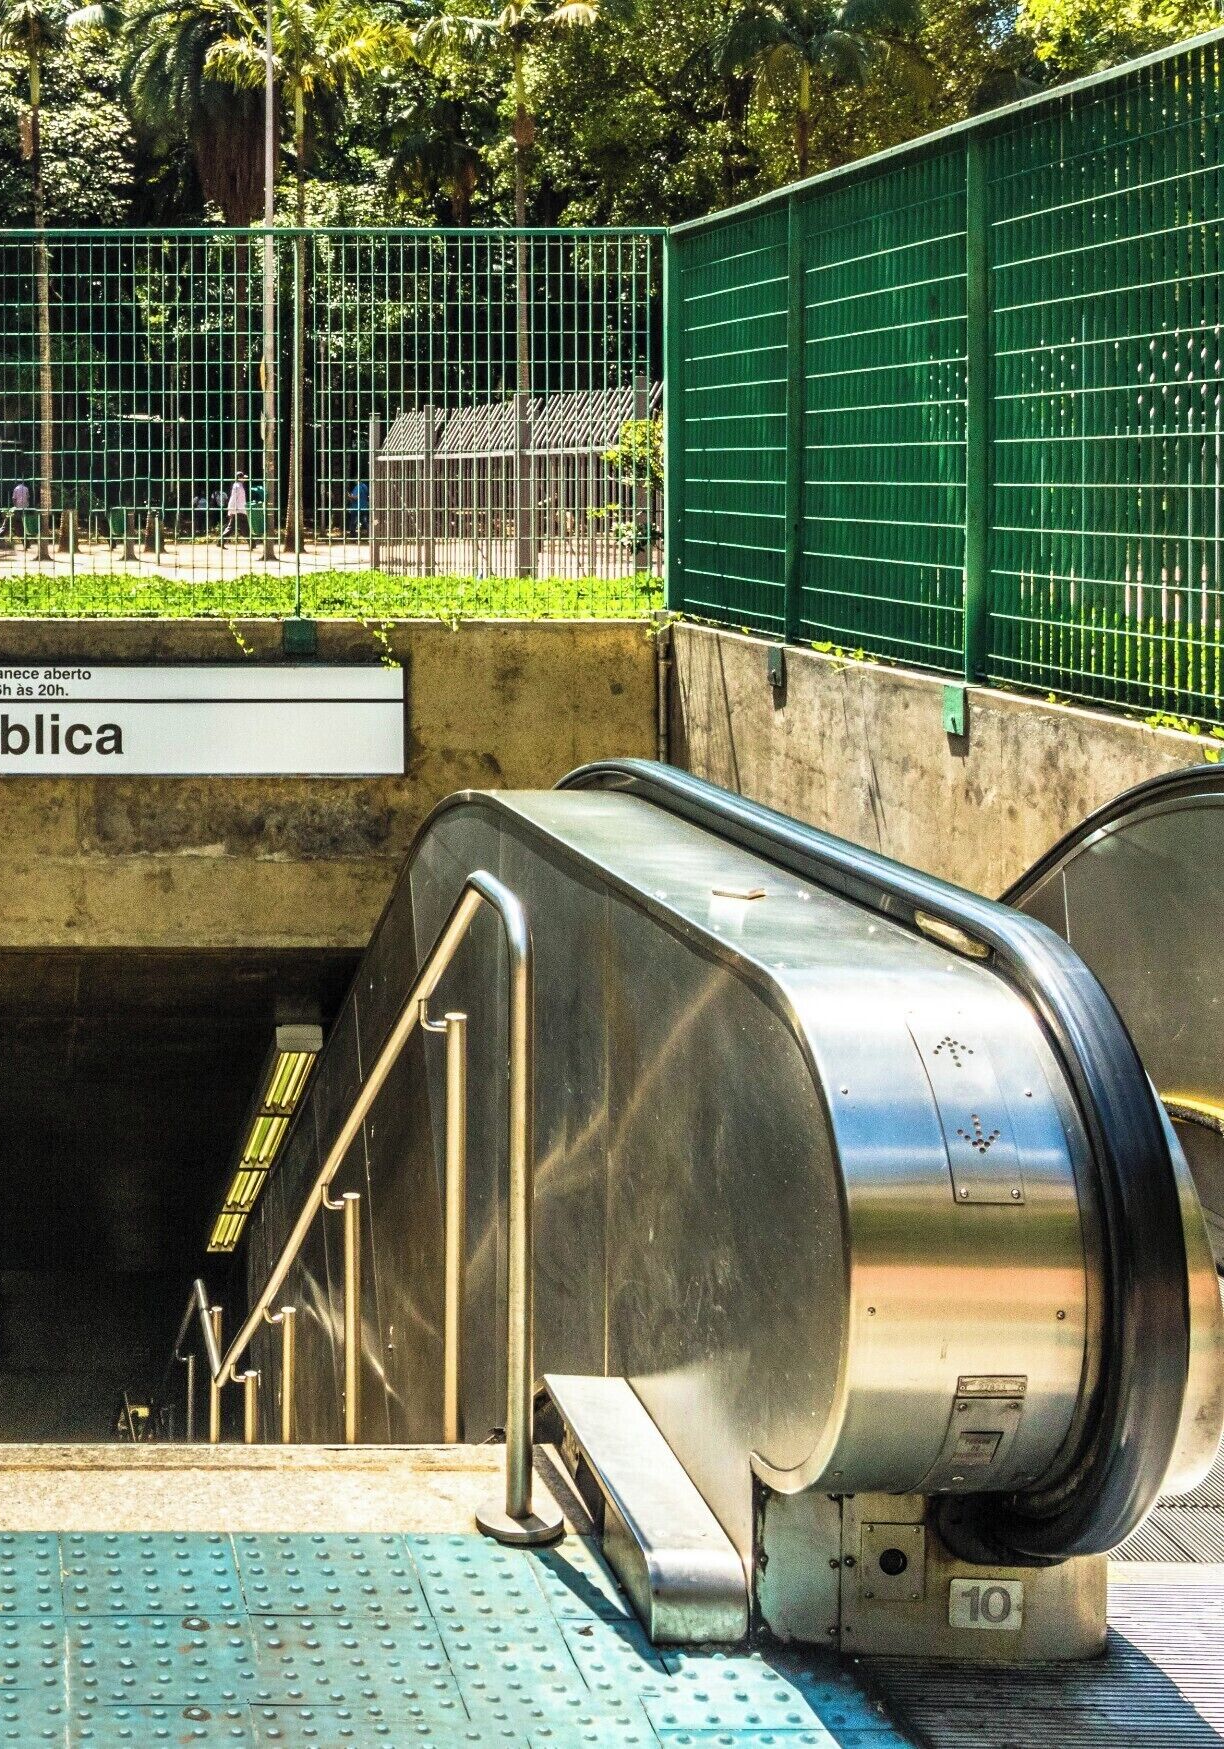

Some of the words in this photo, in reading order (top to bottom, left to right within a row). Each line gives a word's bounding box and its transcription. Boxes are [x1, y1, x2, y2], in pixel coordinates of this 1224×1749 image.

[43, 667, 92, 680] aberto
[16, 684, 34, 697] às
[37, 684, 69, 697] 20h.
[961, 1585, 1012, 1623] 10
